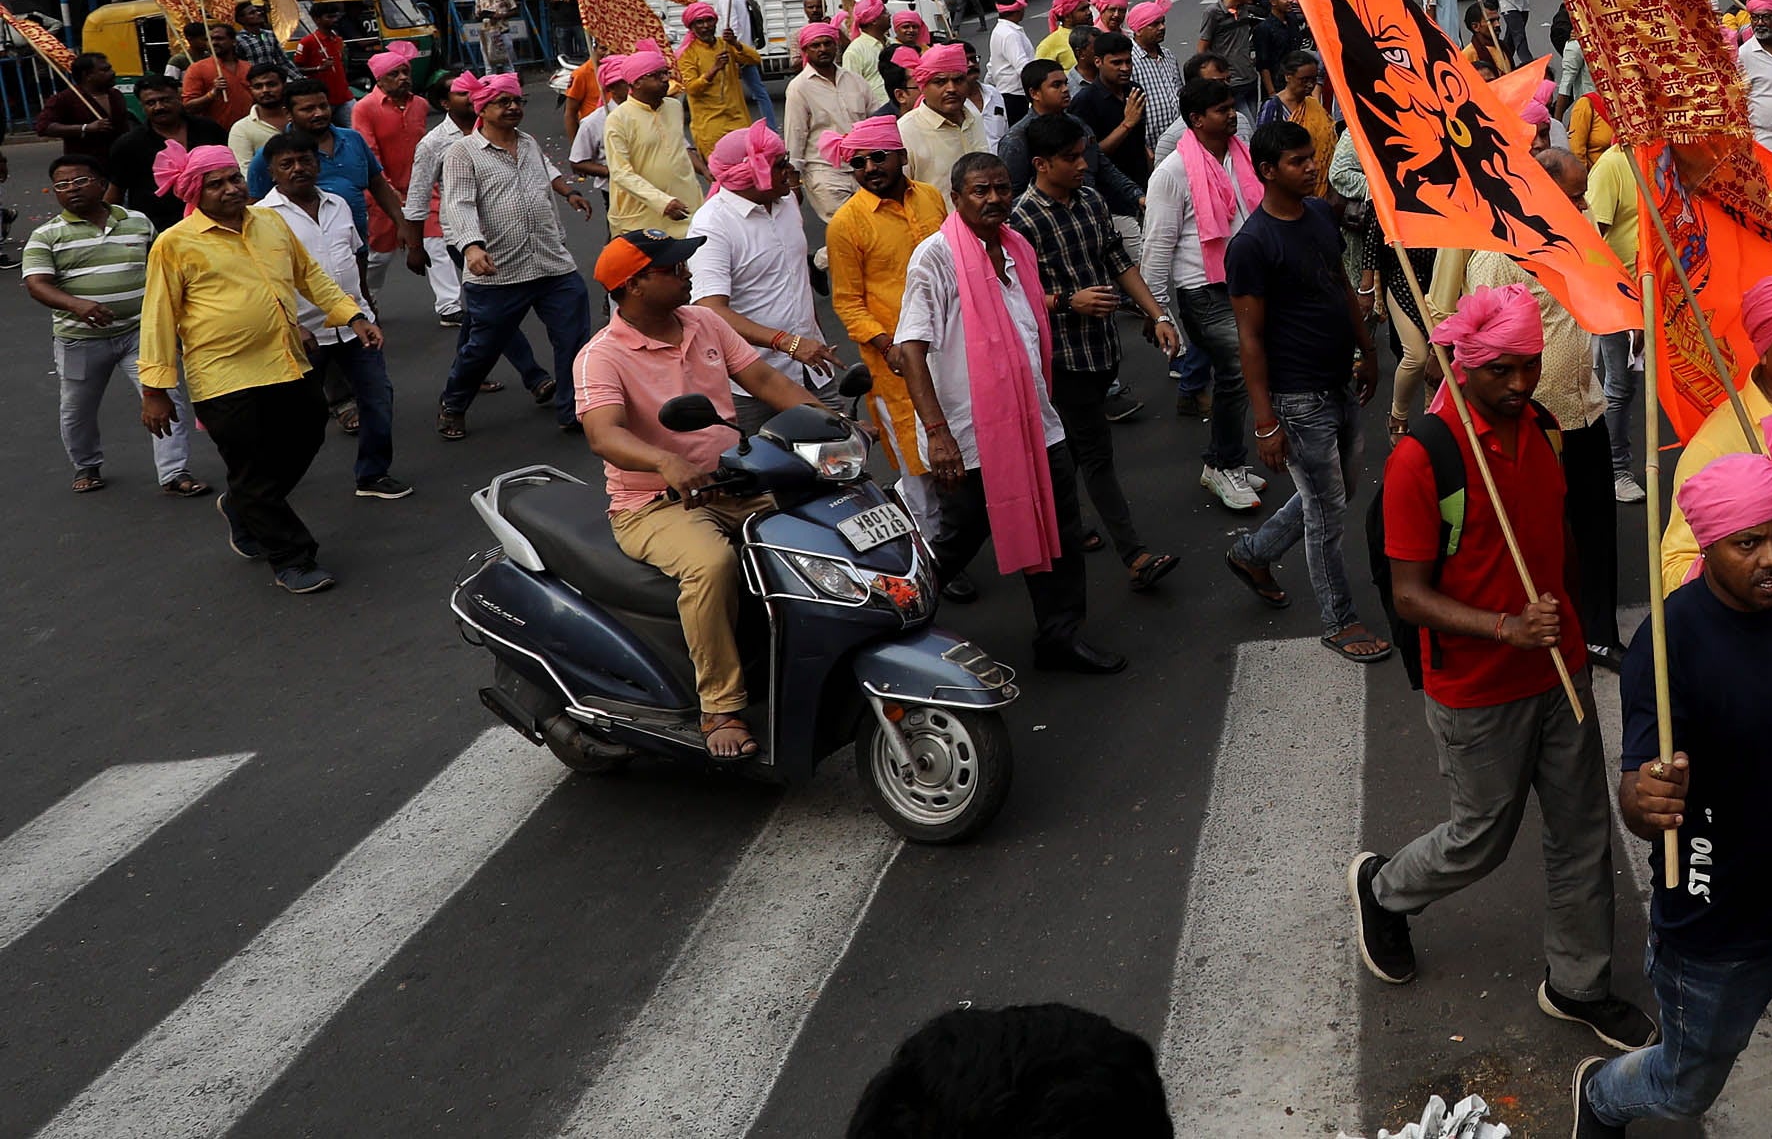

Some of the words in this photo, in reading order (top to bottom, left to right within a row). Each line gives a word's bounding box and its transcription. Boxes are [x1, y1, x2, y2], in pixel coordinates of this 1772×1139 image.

[1602, 10, 1628, 26] राम
[1639, 8, 1664, 22] जय
[1650, 23, 1668, 39] श्री
[1649, 39, 1676, 54] राम
[1663, 80, 1686, 95] जय
[1663, 110, 1689, 124] राम
[1700, 113, 1728, 127] जय
[853, 506, 898, 534] WB01A
